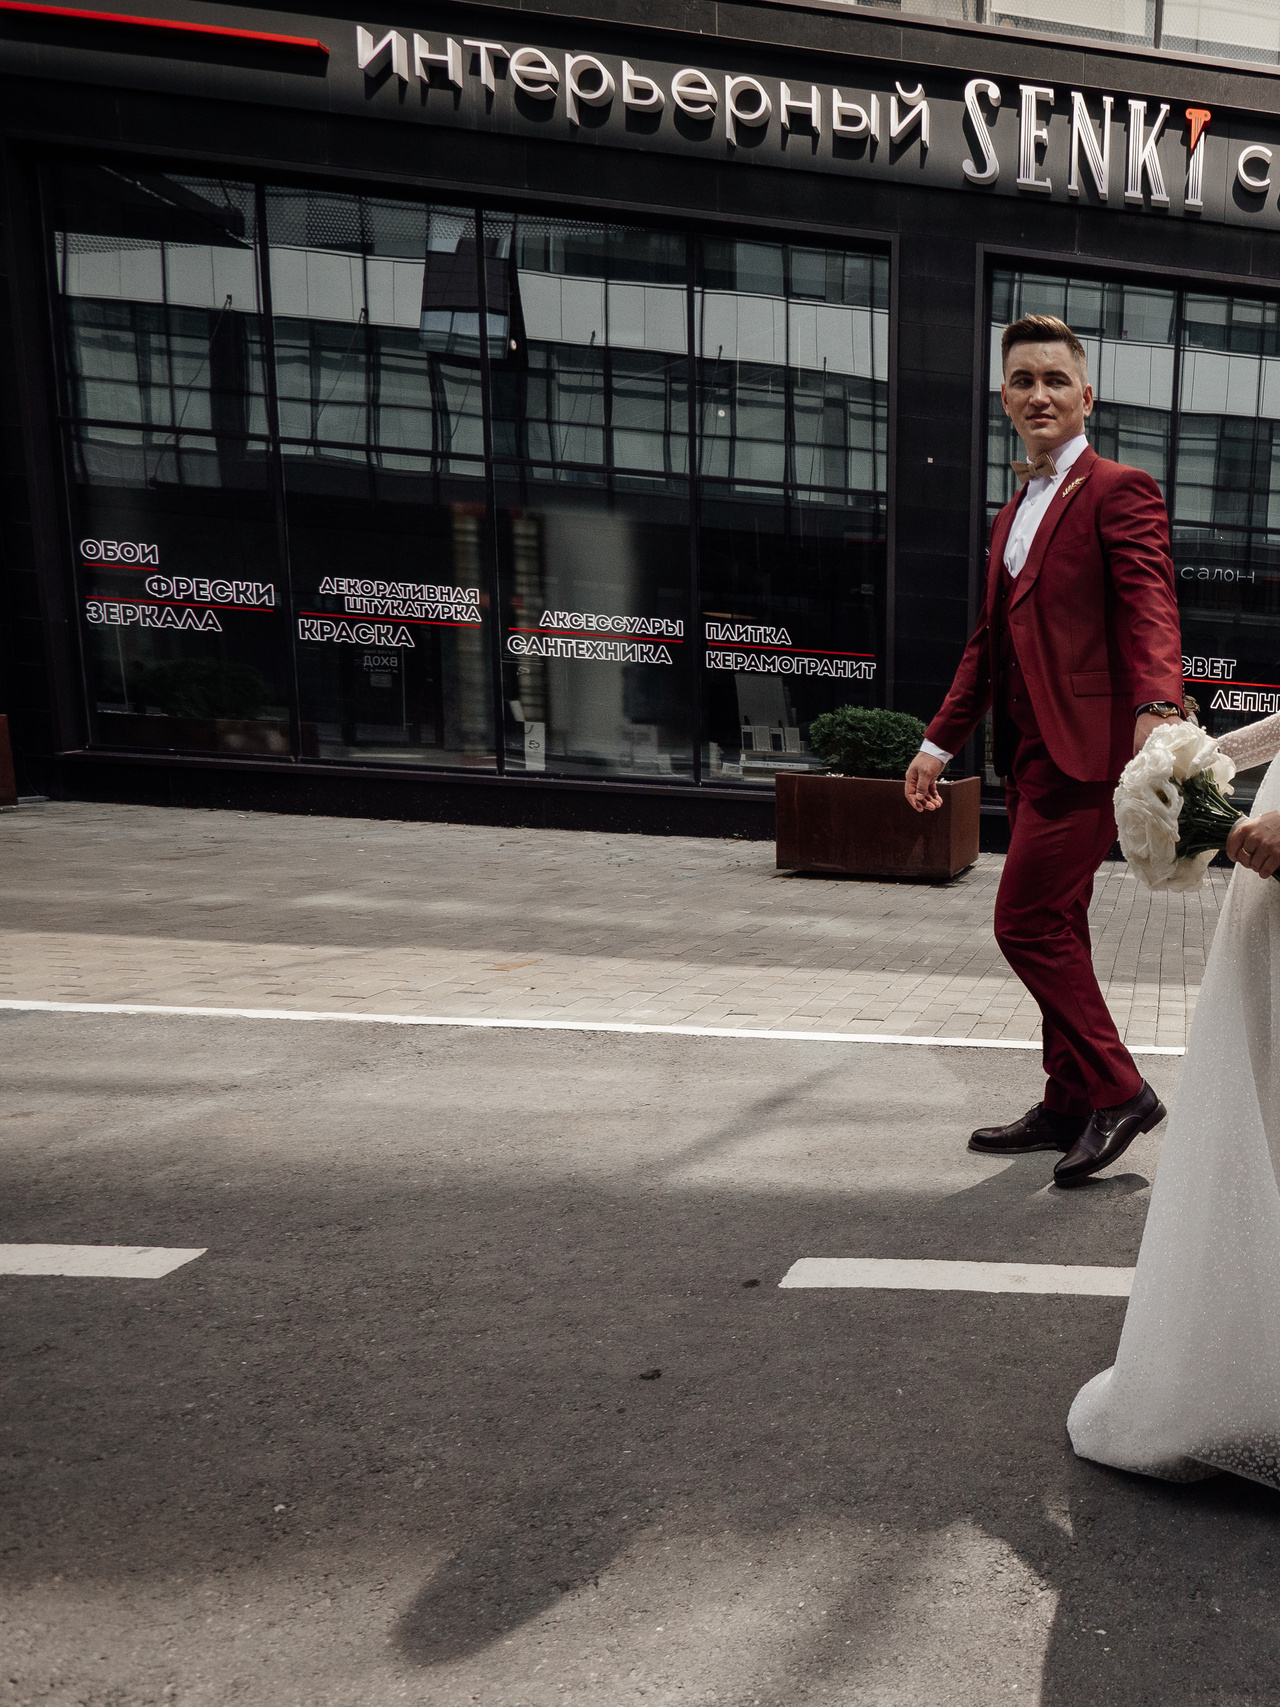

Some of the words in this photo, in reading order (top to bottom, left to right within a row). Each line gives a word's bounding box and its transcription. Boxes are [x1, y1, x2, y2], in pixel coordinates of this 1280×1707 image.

[357, 25, 930, 148] интерьерный
[962, 78, 1212, 212] SENKI
[80, 539, 159, 565] ОБОИ
[1180, 566, 1255, 584] салон
[145, 575, 275, 606] ФРЕСКИ
[319, 576, 481, 605] ДЕКОРАТИВНАЯ
[86, 601, 222, 632] ЗЕРКАЛА
[344, 597, 482, 622] ШТУКАТУРКА
[539, 610, 684, 636] АКСЕССУАРЫ
[298, 618, 415, 648] КРАСКА
[705, 622, 792, 645] ПЛИТКА
[507, 635, 673, 665] САНТЕХНИКА
[705, 651, 877, 679] КЕРАМОГРАНИТ
[1181, 655, 1236, 679] СВЕТ
